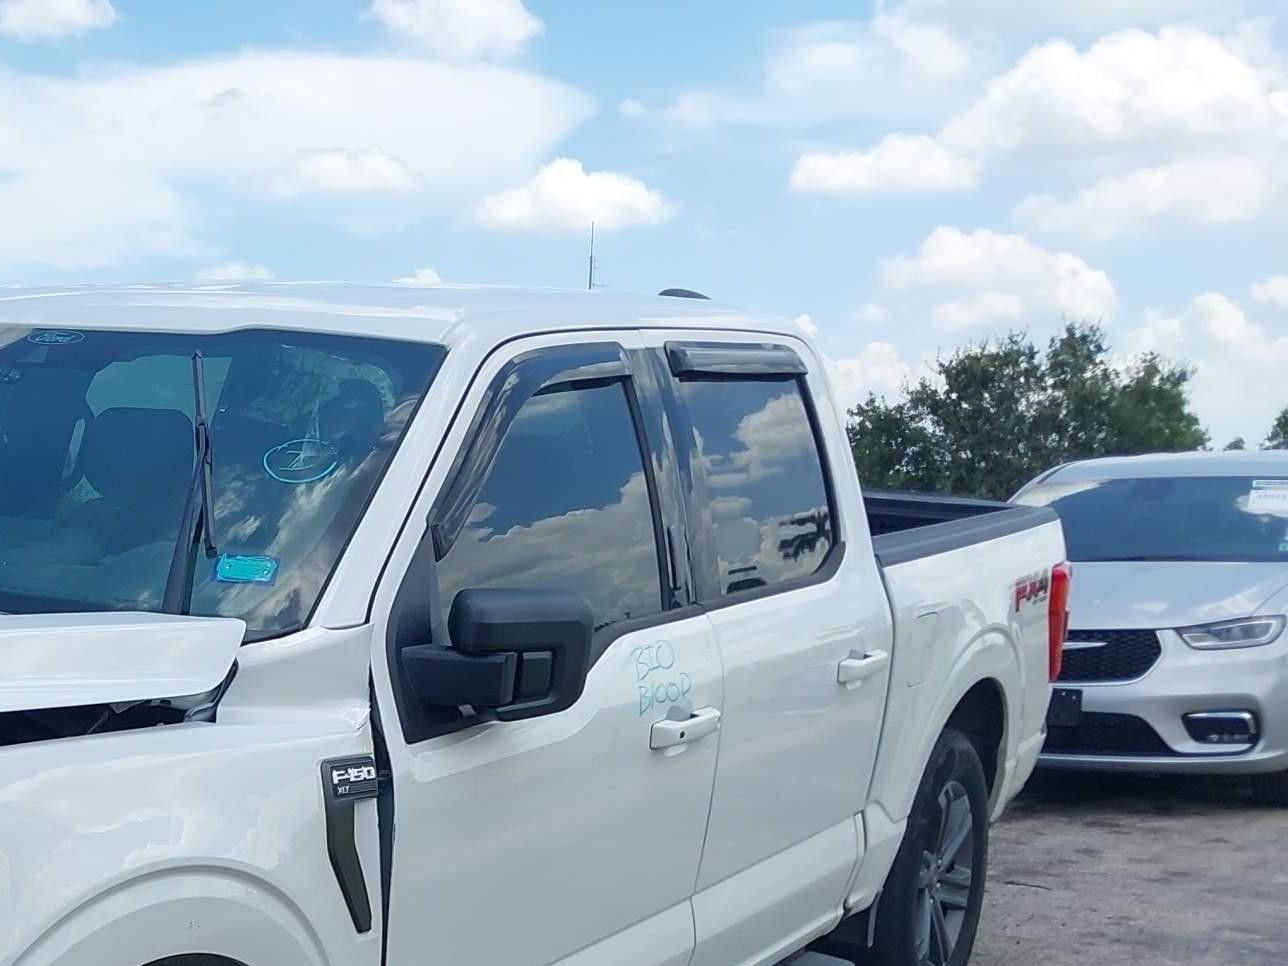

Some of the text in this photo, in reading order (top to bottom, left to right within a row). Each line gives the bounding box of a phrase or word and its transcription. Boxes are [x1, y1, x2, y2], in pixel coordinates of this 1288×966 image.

[631, 639, 674, 681] BIO
[332, 766, 376, 785] F-150
[337, 785, 350, 796] XLT
